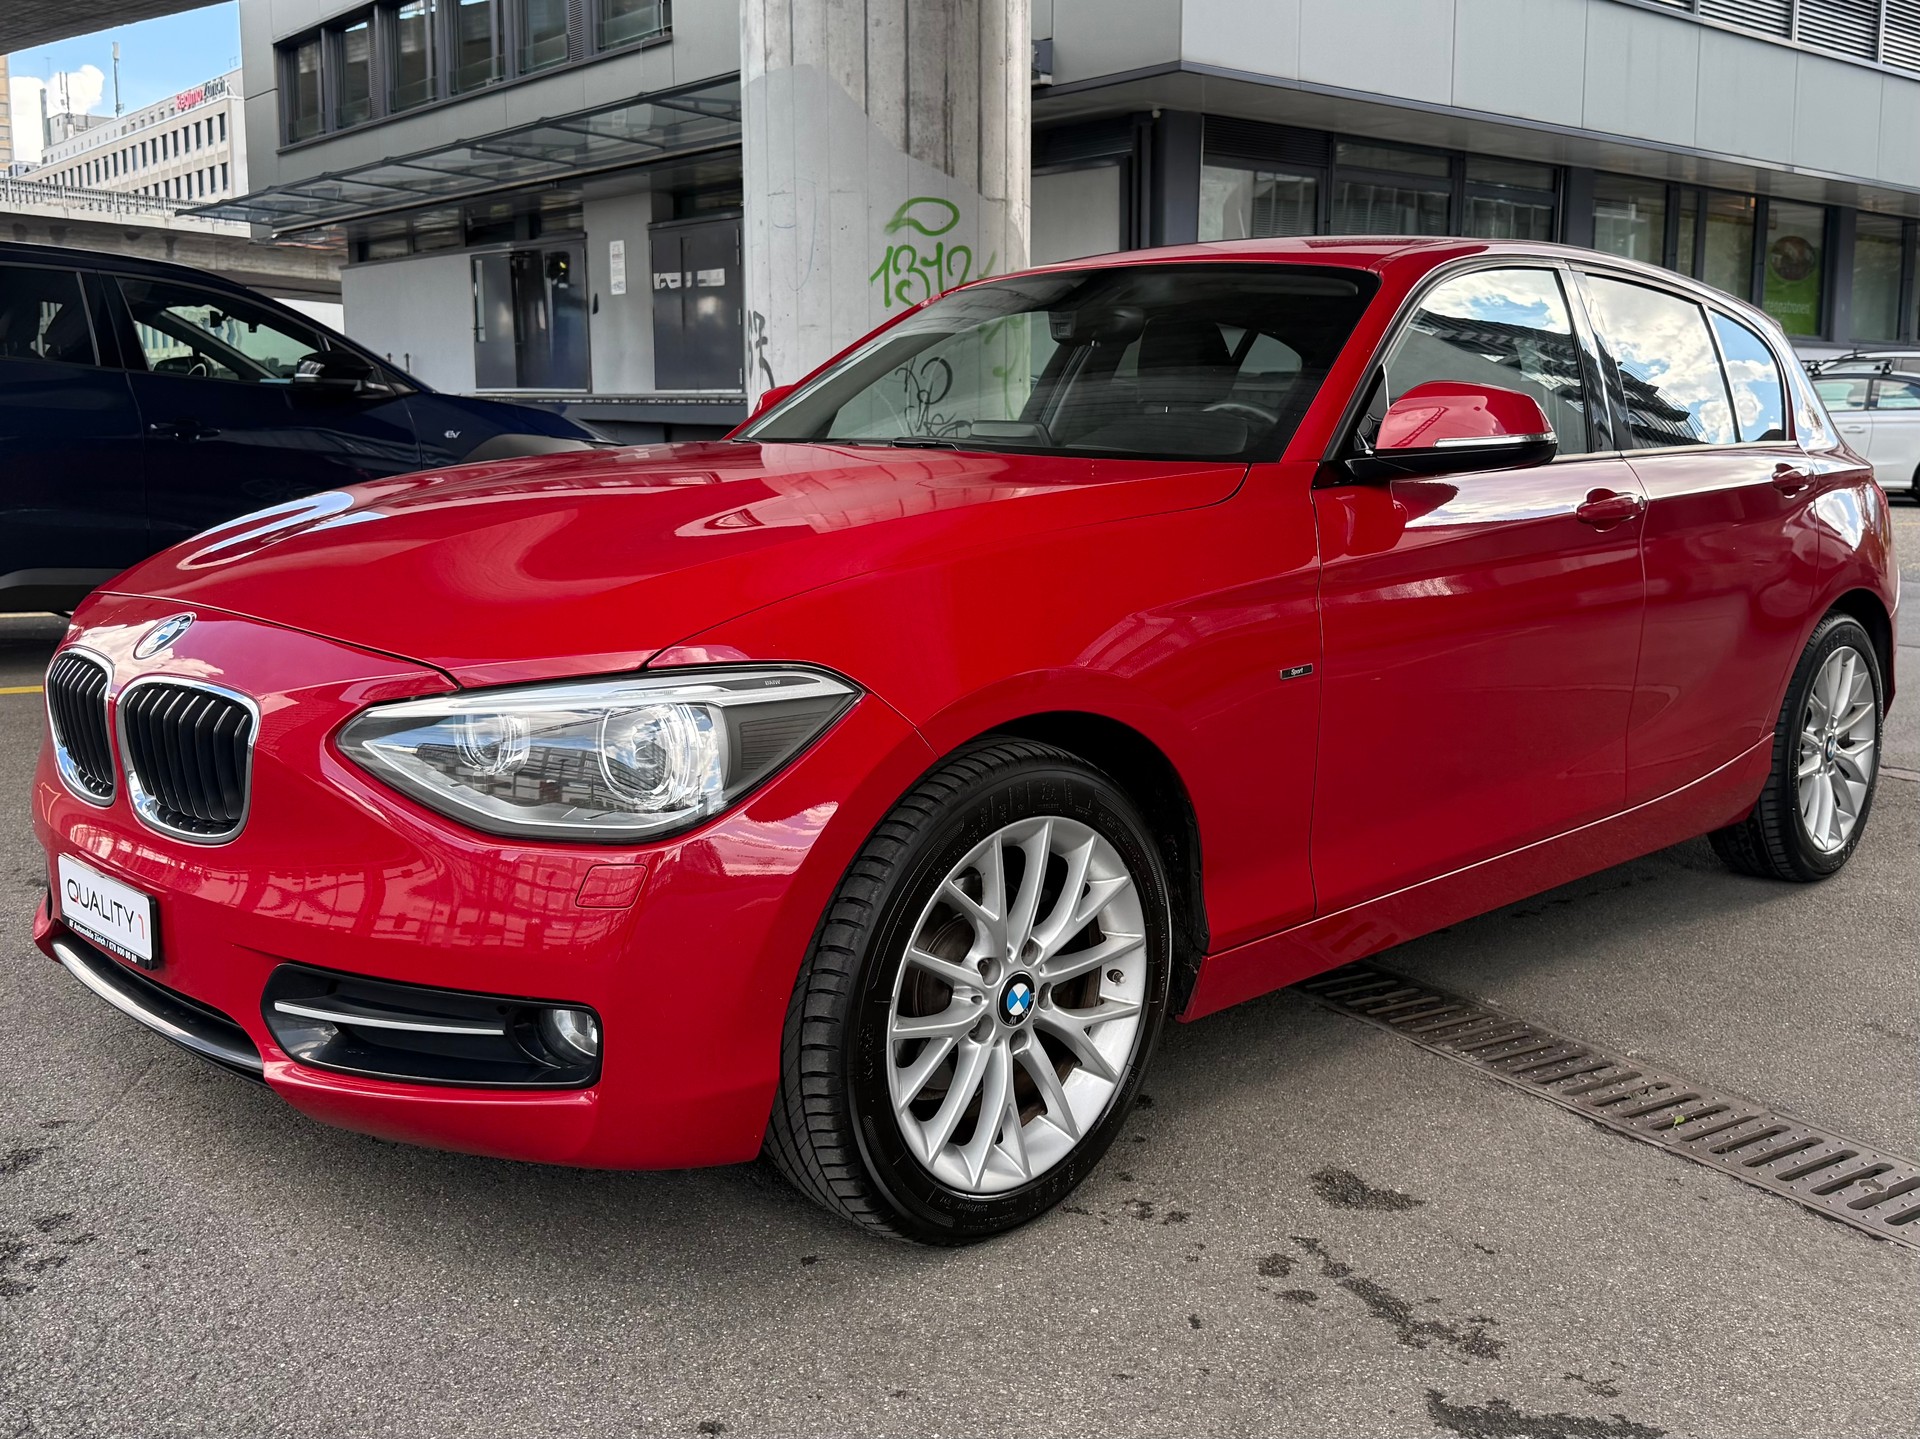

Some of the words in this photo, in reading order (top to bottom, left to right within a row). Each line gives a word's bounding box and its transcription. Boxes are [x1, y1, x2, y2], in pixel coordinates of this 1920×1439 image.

[1290, 667, 1304, 676] Sport
[67, 878, 134, 933] QUALITY
[138, 914, 145, 940] 1
